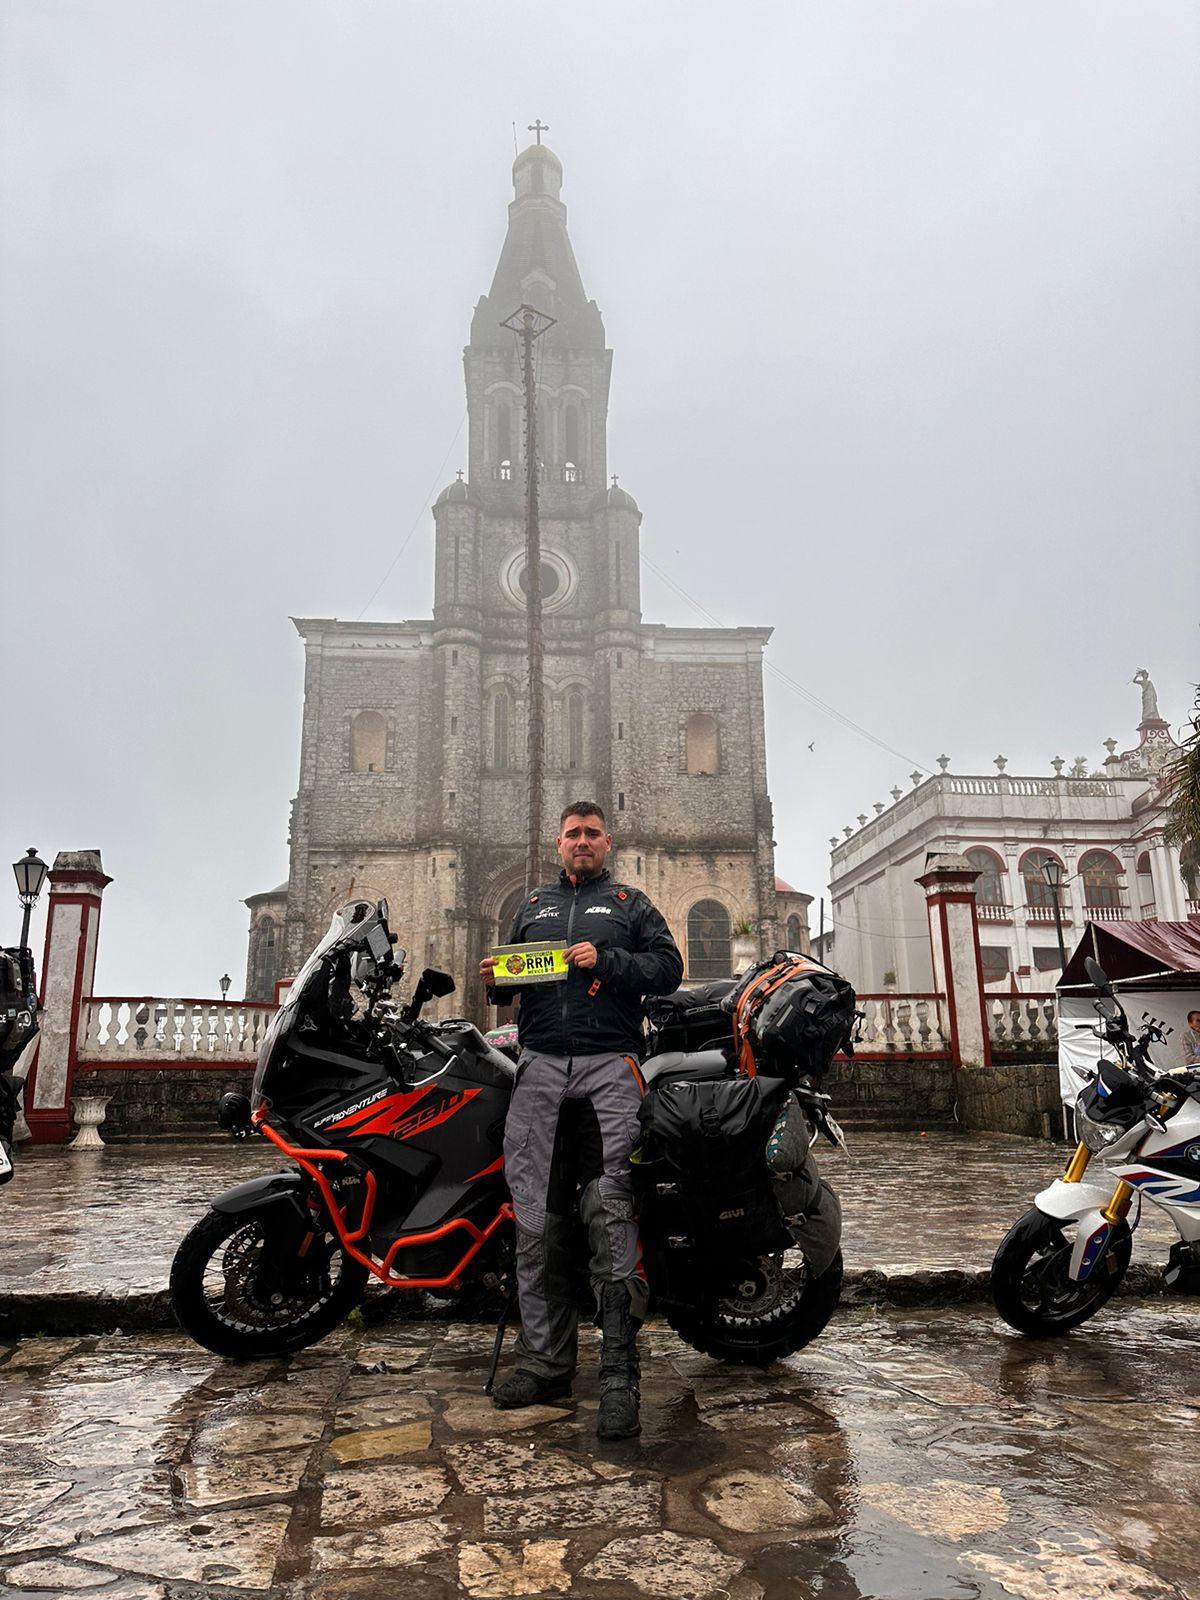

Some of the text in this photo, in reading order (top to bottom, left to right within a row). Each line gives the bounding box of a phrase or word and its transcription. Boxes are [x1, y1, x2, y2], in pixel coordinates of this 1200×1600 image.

[585, 906, 612, 914] KTM
[527, 956, 554, 969] RRM
[332, 1088, 388, 1122] ADVENTURE
[718, 1207, 745, 1219] GIVI
